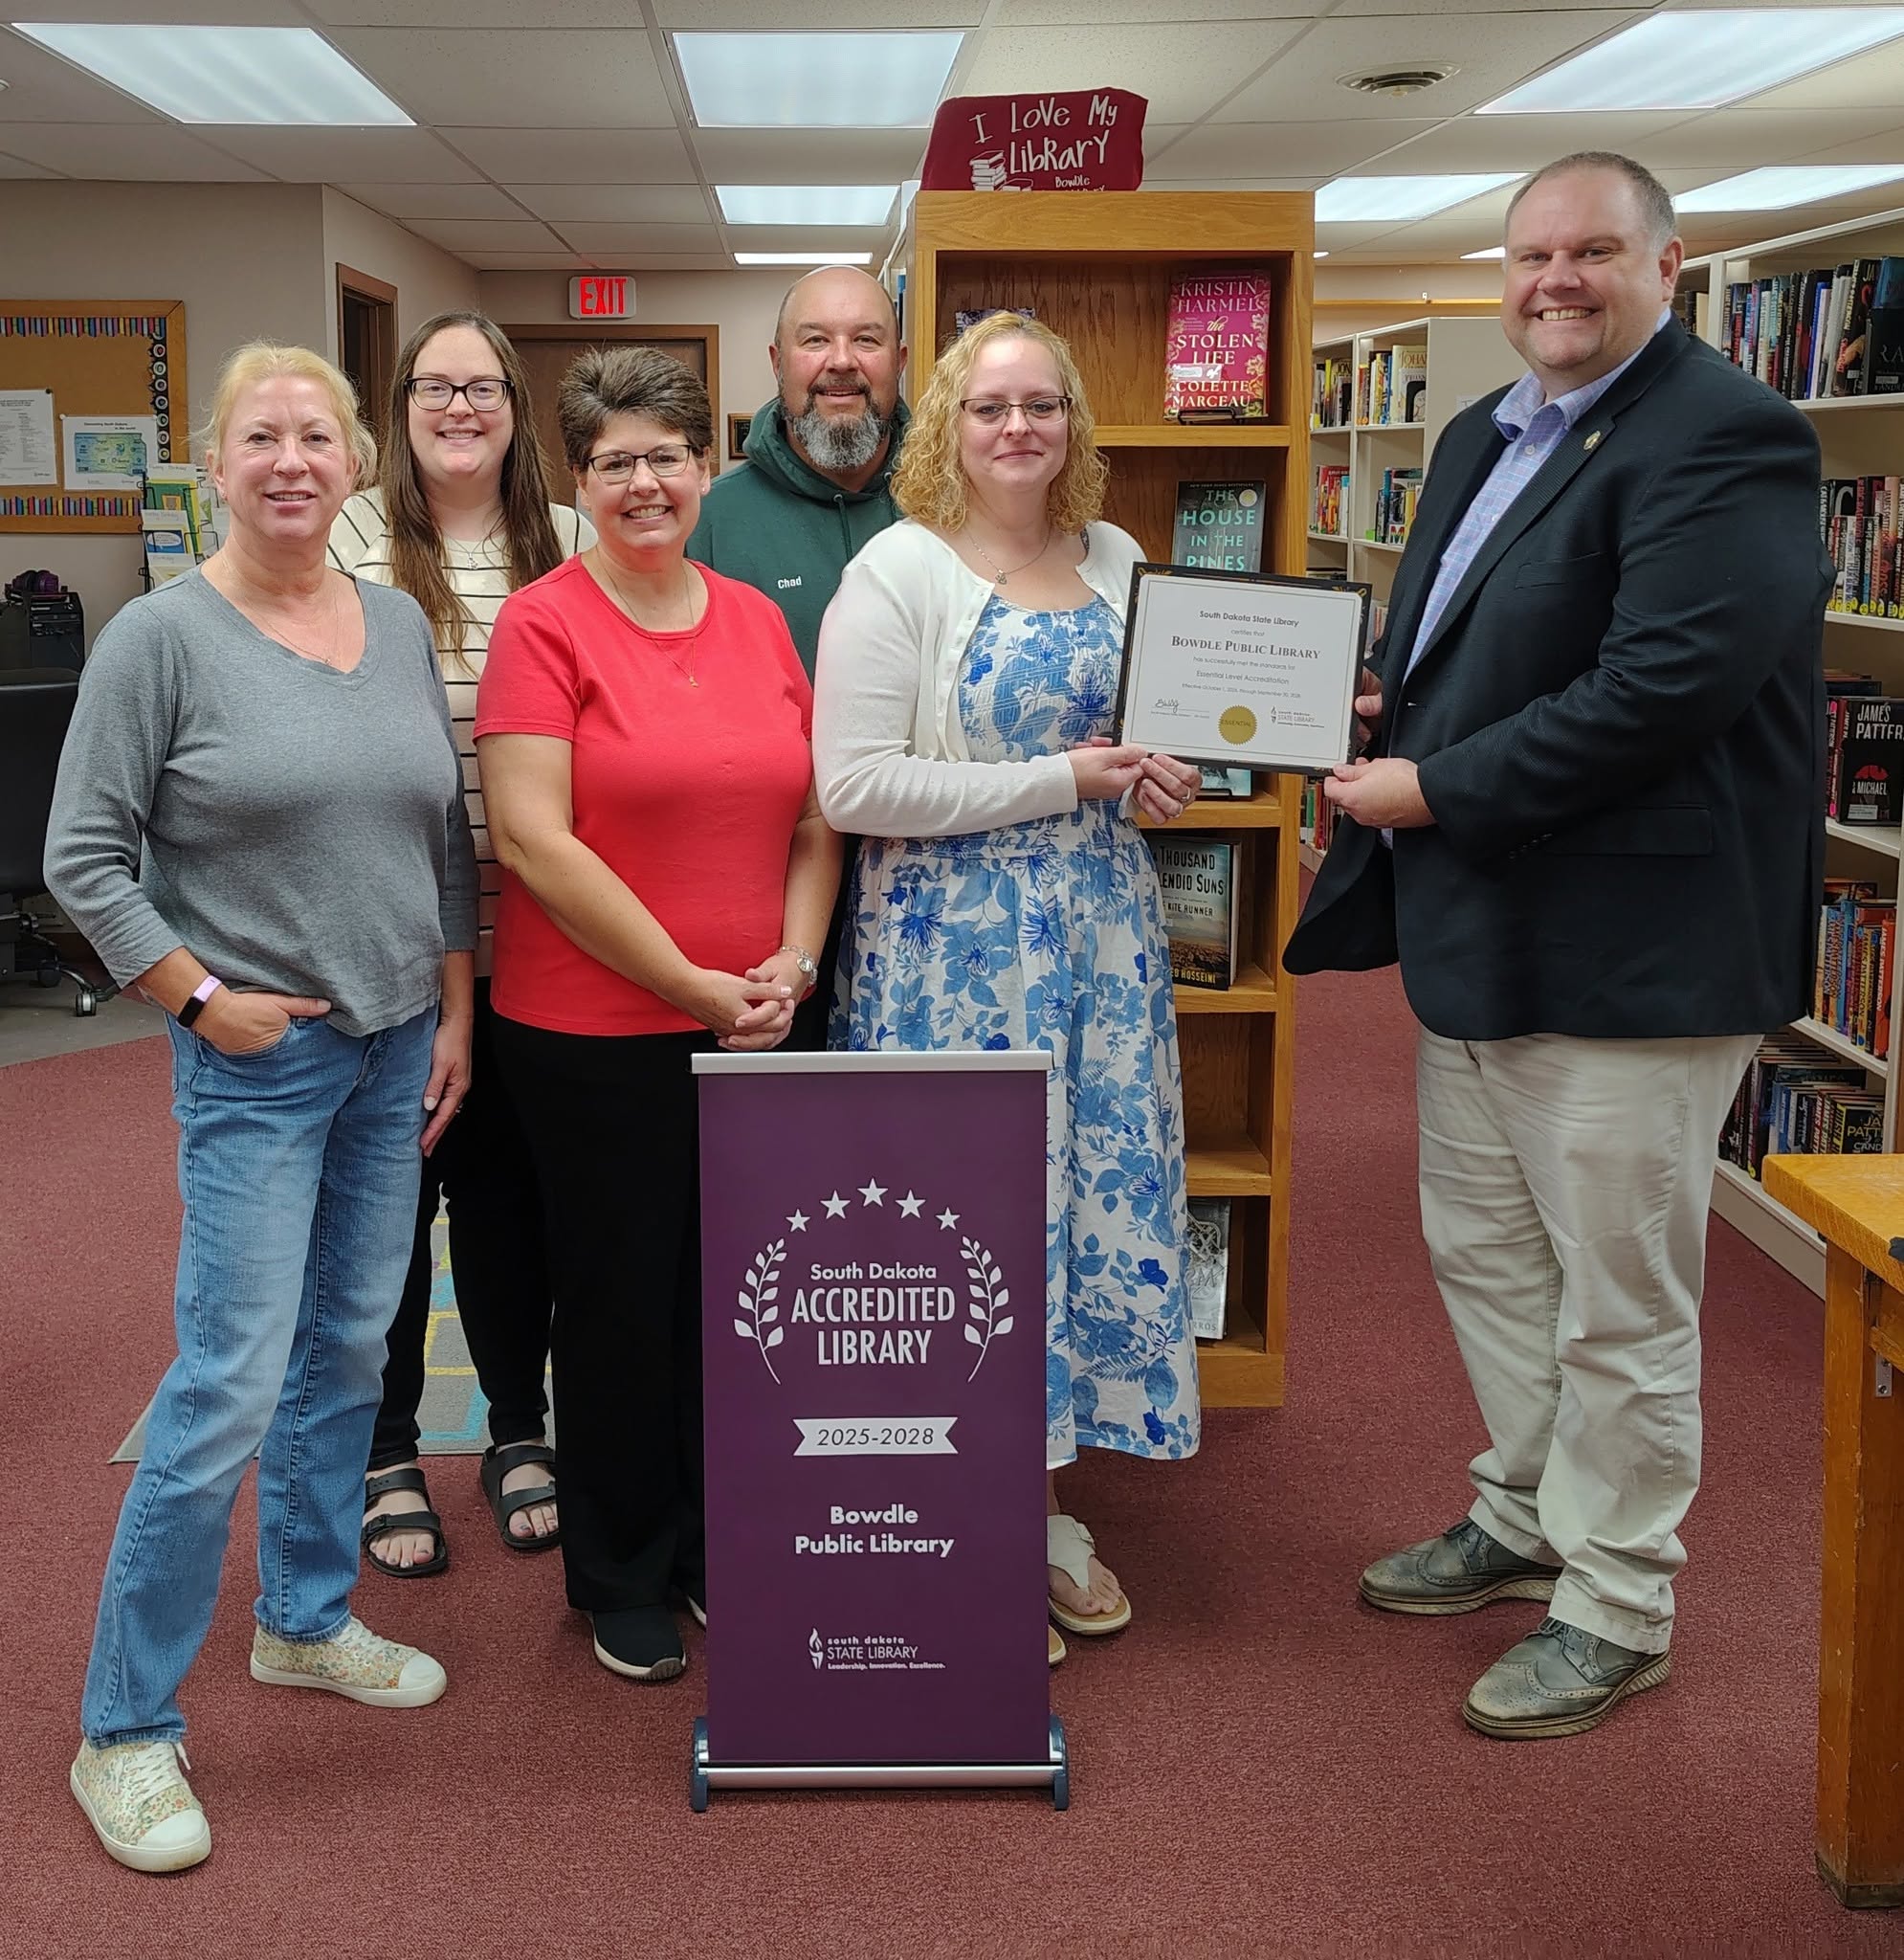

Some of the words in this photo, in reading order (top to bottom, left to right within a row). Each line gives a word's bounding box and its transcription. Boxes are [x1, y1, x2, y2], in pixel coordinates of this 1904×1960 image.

[969, 113, 993, 144] I
[1088, 95, 1118, 126] My
[580, 278, 627, 315] EXIT
[1180, 281, 1258, 298] KRISTIN
[1178, 298, 1259, 313] HARMEL
[1207, 316, 1229, 333] the
[1177, 333, 1254, 349] STOLEN
[1191, 350, 1235, 366] LIFE
[1206, 364, 1222, 378] of
[1176, 380, 1250, 393] COLETTE
[1172, 394, 1251, 409] MARCEAU
[1206, 489, 1235, 501] THE
[1183, 509, 1255, 525] HOUSE
[1190, 535, 1207, 546] IN
[1214, 535, 1244, 547] THE
[1186, 555, 1245, 571] PINES
[778, 576, 802, 589] Chad
[1199, 610, 1221, 619] South
[1223, 612, 1251, 622] Dakota
[1252, 614, 1272, 624] State
[1273, 616, 1299, 628] Library
[1230, 629, 1251, 637] certifies
[1171, 635, 1222, 651] BOWDLE
[1225, 640, 1267, 655] PUBLIC
[1270, 644, 1320, 659] LIBRARY
[1207, 657, 1236, 667] successfully
[1259, 661, 1287, 670] standards
[1196, 670, 1224, 679] Essential
[1226, 672, 1243, 680] Level
[1244, 674, 1290, 684] Accreditation
[1857, 702, 1892, 723] JAMES
[1856, 723, 1904, 740] PATTER
[1857, 781, 1888, 795] MICHAEL
[1160, 845, 1215, 871] THOUSAND
[1196, 873, 1225, 896] SUNS
[1167, 902, 1183, 914] KITE
[1184, 905, 1213, 917] RUNNER
[1181, 969, 1216, 984] HOSSEINI
[810, 1261, 863, 1281] South
[869, 1261, 937, 1280] Dakota
[790, 1287, 956, 1323] ACCREDITED
[818, 1329, 933, 1366] LIBRARY
[817, 1428, 934, 1446] 2025-2028
[830, 1503, 919, 1525] Bowdle
[795, 1534, 864, 1554] Public
[870, 1533, 954, 1558] Library
[828, 1636, 859, 1645] south
[865, 1636, 904, 1644] dakota
[827, 1646, 863, 1659] STATE
[869, 1646, 919, 1659] LIBRARY
[828, 1662, 868, 1671] Leadership.
